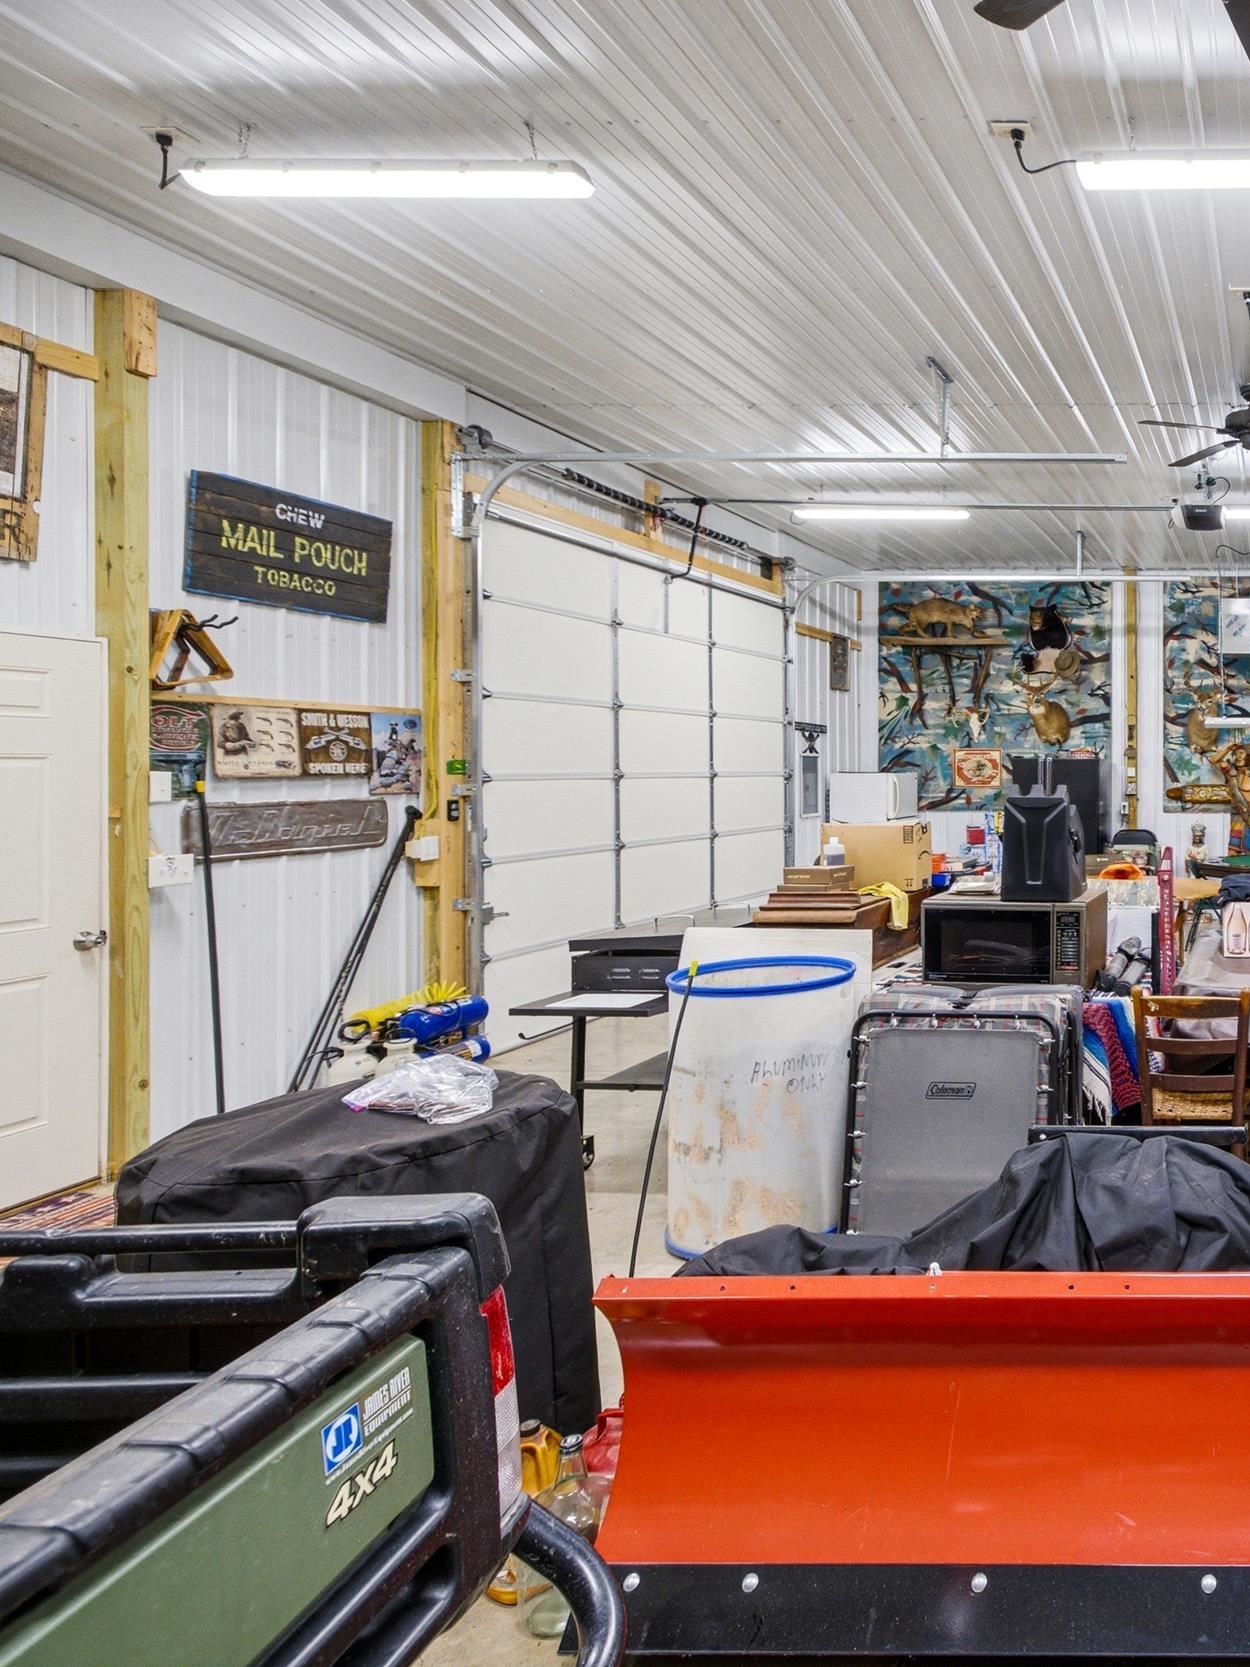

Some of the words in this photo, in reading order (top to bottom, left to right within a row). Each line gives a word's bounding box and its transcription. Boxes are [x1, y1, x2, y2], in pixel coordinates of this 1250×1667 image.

[276, 503, 326, 529] CHEW
[220, 519, 284, 559] MAIL
[294, 536, 368, 577] POUCH
[254, 566, 337, 596] TOBACCO
[930, 1084, 966, 1095] Coleman
[363, 1384, 389, 1420] JAMES
[389, 1366, 411, 1398] RIVER
[364, 1389, 412, 1437] EQUIPMENT
